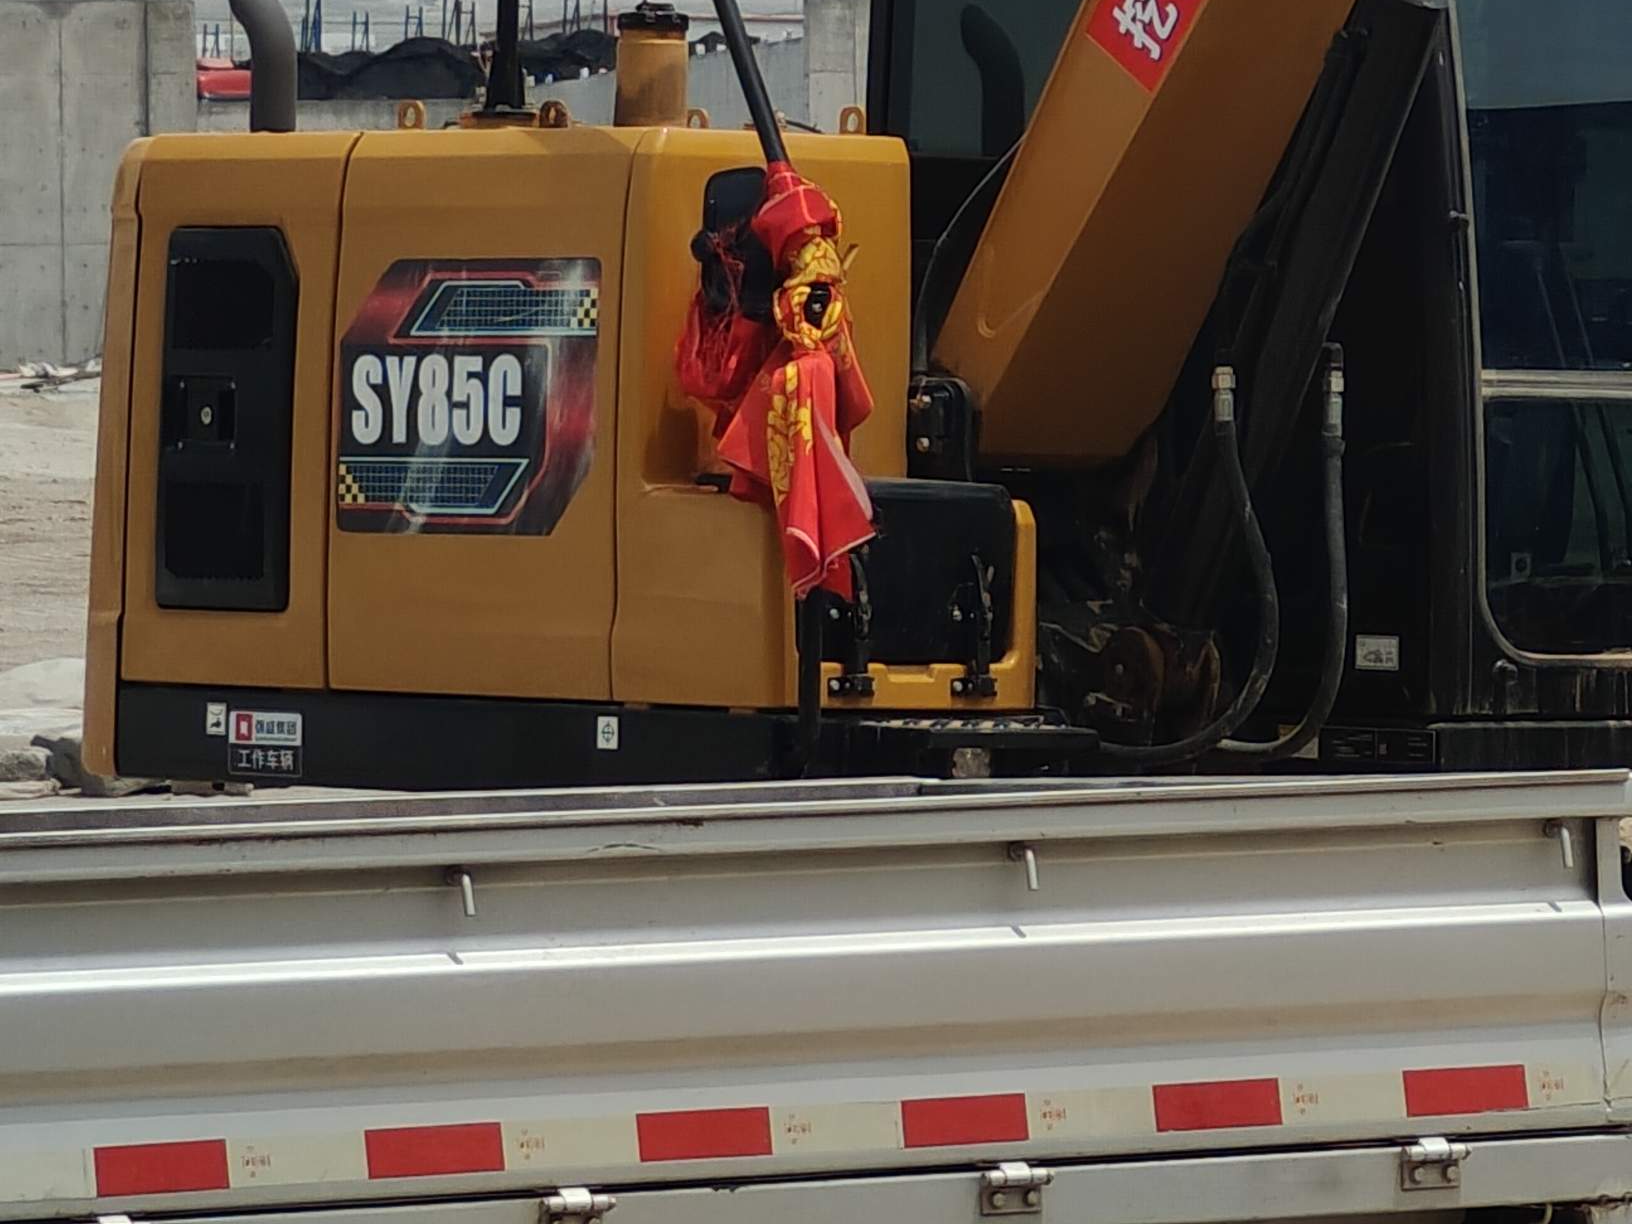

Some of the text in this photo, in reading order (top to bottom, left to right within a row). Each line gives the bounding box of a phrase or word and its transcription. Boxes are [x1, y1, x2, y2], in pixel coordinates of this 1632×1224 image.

[351, 352, 523, 448] SY85C
[237, 748, 294, 771] 工作车辆
